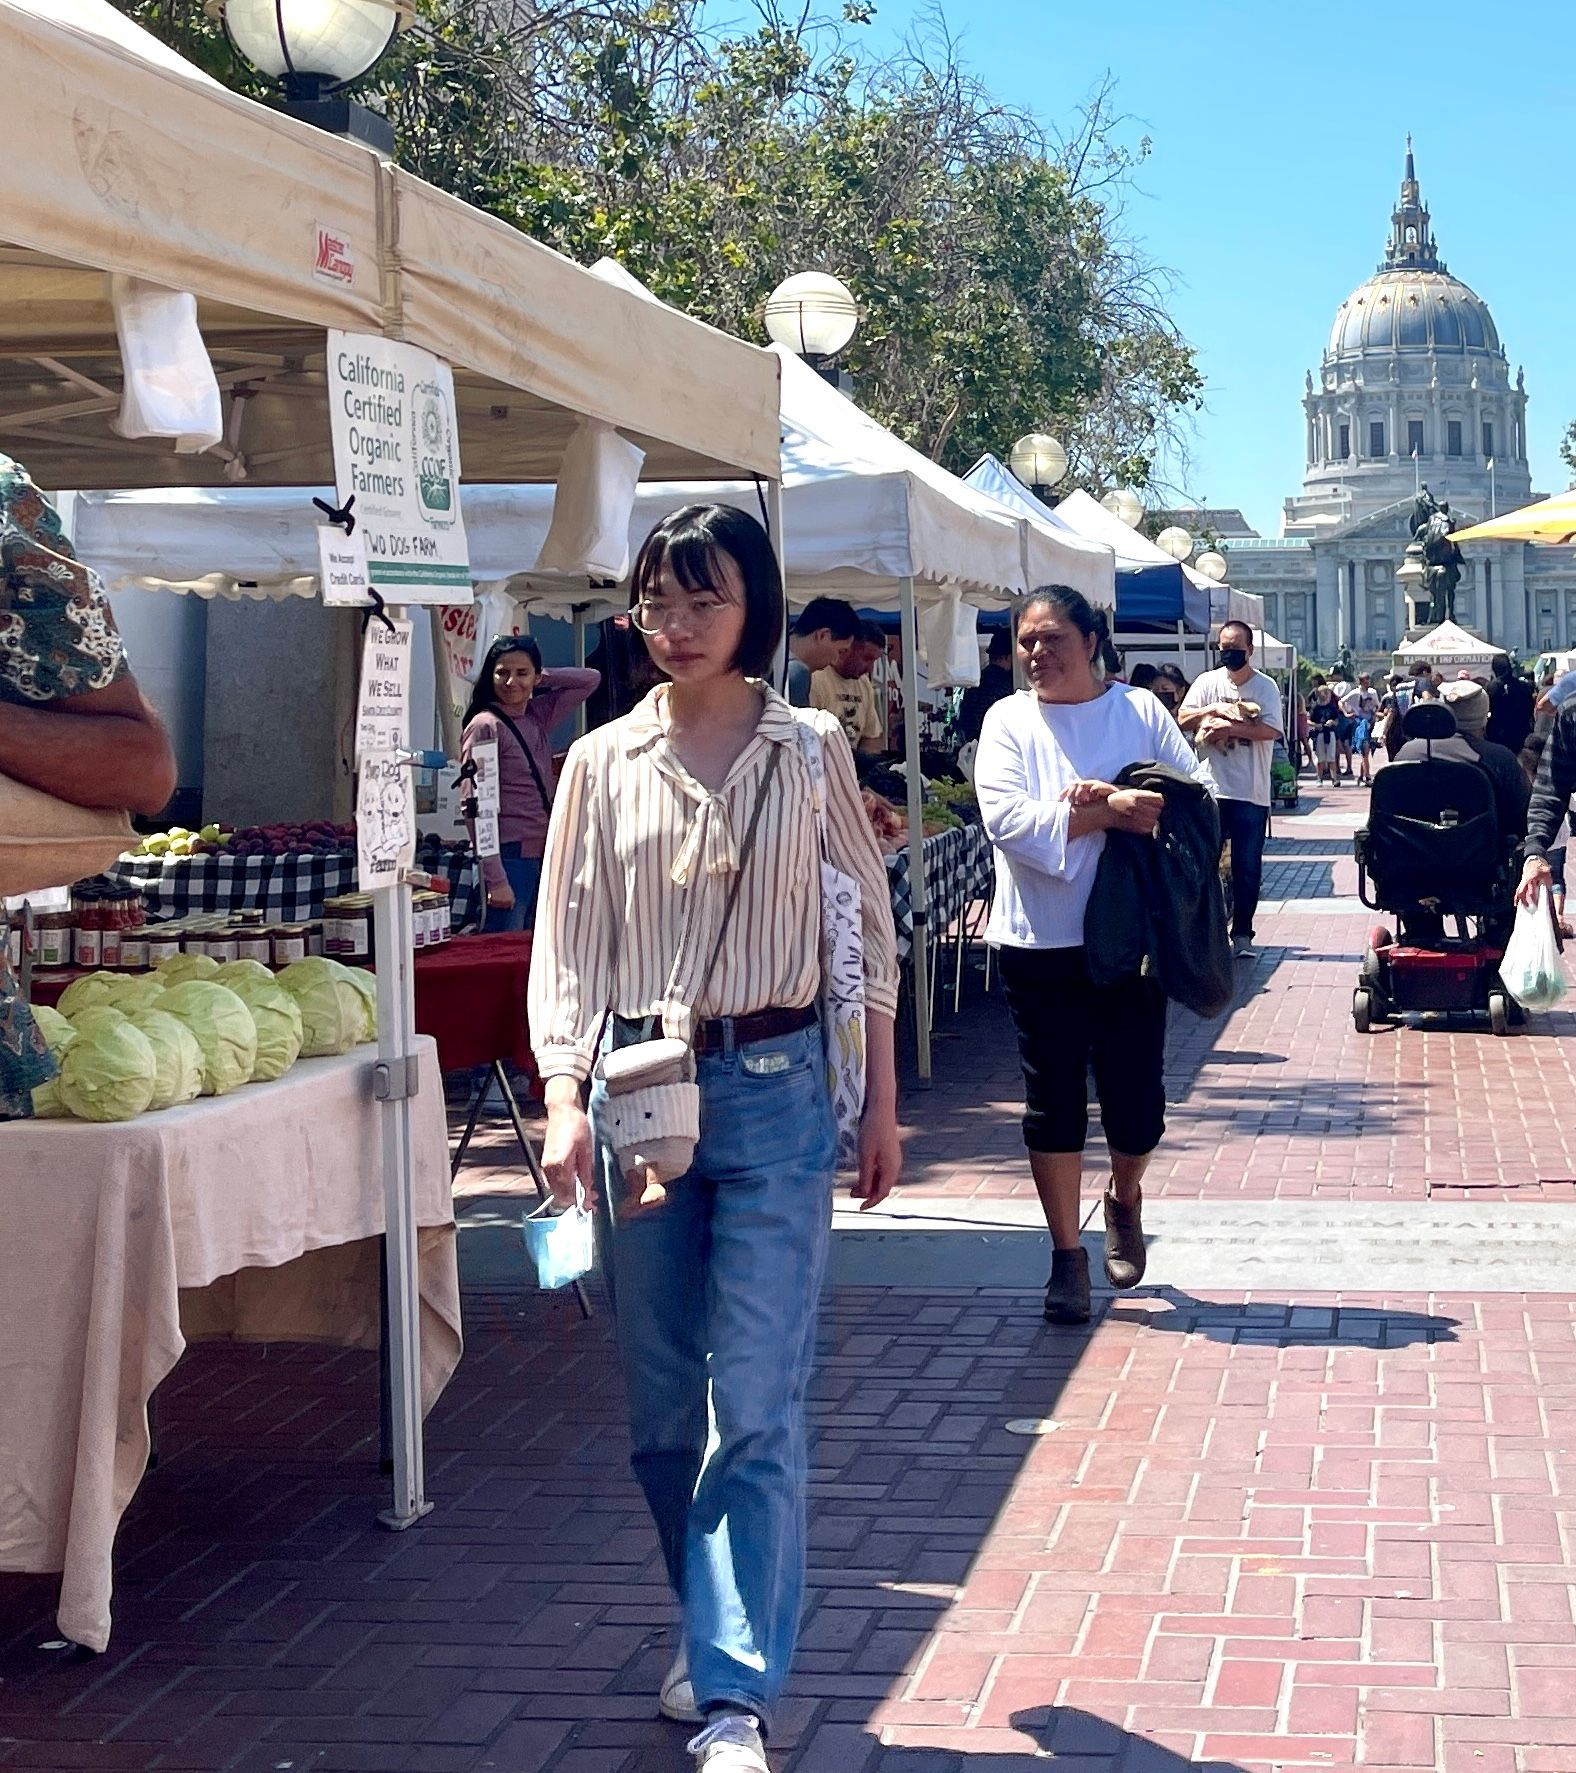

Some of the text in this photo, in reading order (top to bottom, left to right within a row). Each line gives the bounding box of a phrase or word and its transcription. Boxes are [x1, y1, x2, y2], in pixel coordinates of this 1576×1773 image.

[338, 352, 405, 393] California
[344, 390, 402, 427] Certified
[350, 426, 401, 465] Organic
[351, 463, 404, 496] Farmers
[422, 456, 446, 481] CCOF
[390, 534, 410, 557] DOG
[412, 536, 439, 557] FARM
[330, 572, 348, 585] Credit
[349, 573, 366, 585] Cards
[376, 653, 399, 671] WHAT
[368, 679, 402, 697] WE SELL
[381, 760, 400, 782] Dog
